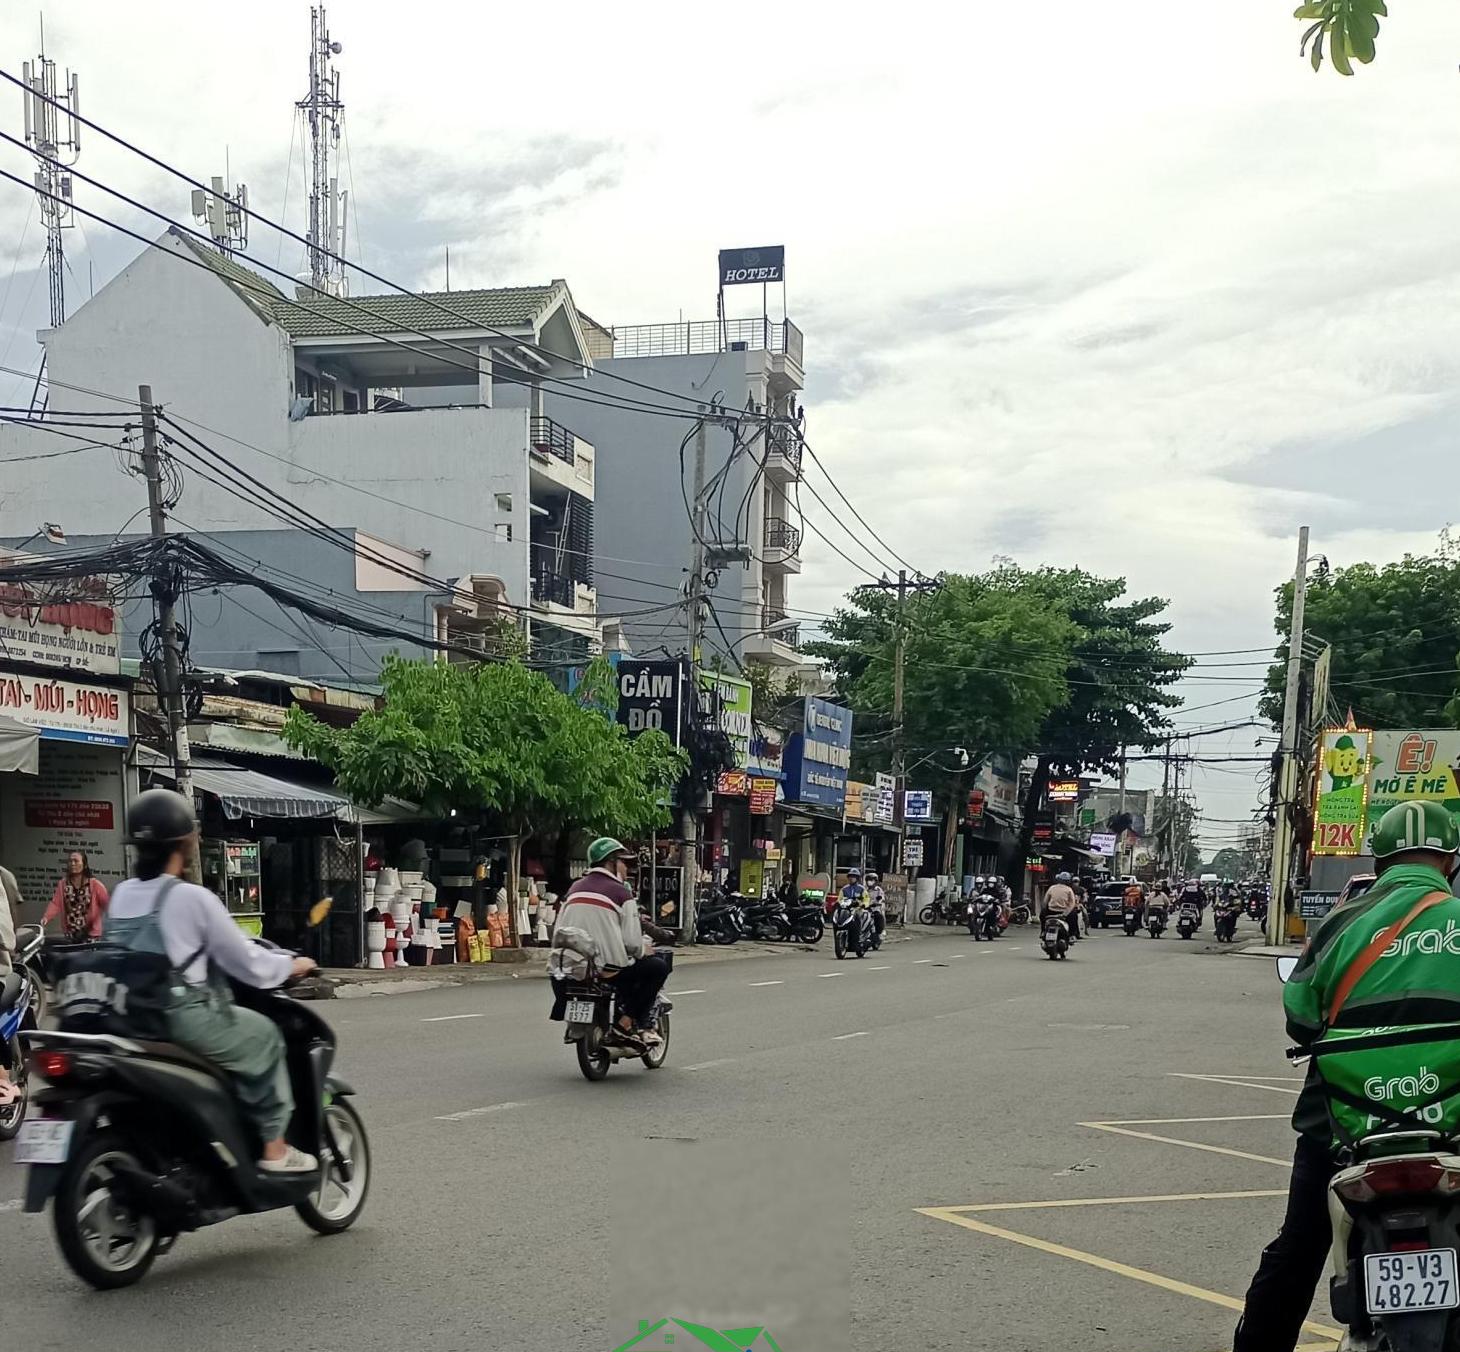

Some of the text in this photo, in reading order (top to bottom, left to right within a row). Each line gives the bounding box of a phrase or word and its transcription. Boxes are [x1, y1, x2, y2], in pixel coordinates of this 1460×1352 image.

[725, 266, 779, 282] HOTEL
[621, 667, 672, 698] CẦM
[76, 689, 118, 723] HỌNG
[628, 700, 662, 731] ĐỒ
[1396, 732, 1437, 774] Ê!
[1374, 775, 1447, 794] MỜ Ê MÊ
[1318, 823, 1355, 849] 12K
[1364, 1066, 1440, 1101] Grab
[1378, 1254, 1442, 1281] 59-V3
[1375, 1280, 1450, 1309] 482.27
